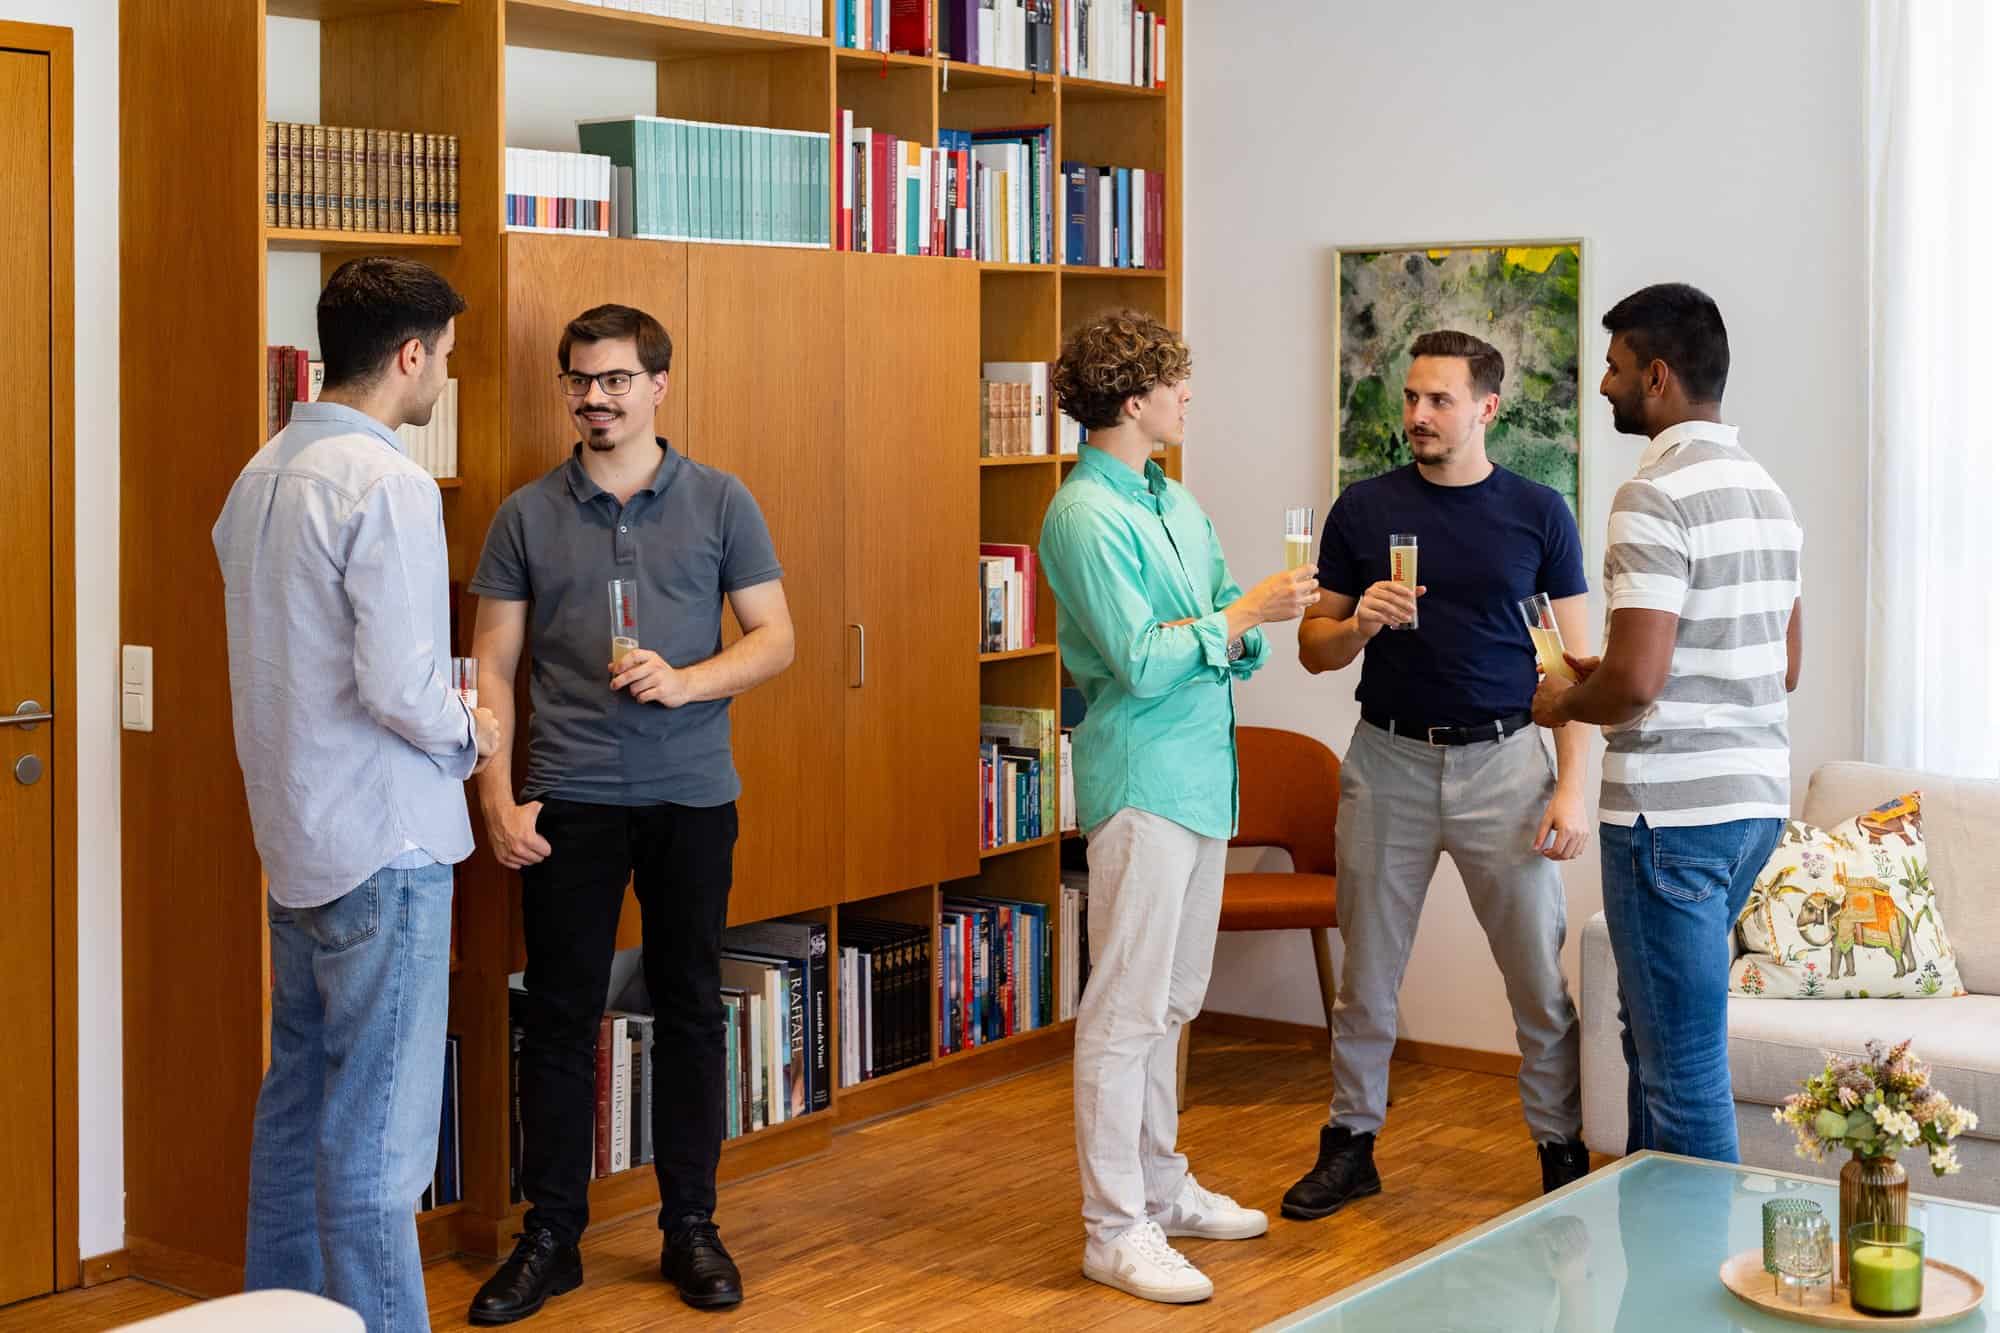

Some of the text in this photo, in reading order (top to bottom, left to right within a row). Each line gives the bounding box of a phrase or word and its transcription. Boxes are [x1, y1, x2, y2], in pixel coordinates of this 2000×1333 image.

[791, 977, 803, 1057] RAFFAEL
[816, 991, 824, 1033] Leonardo
[816, 1044, 824, 1069] Vinci
[615, 1063, 625, 1147] Frankreich
